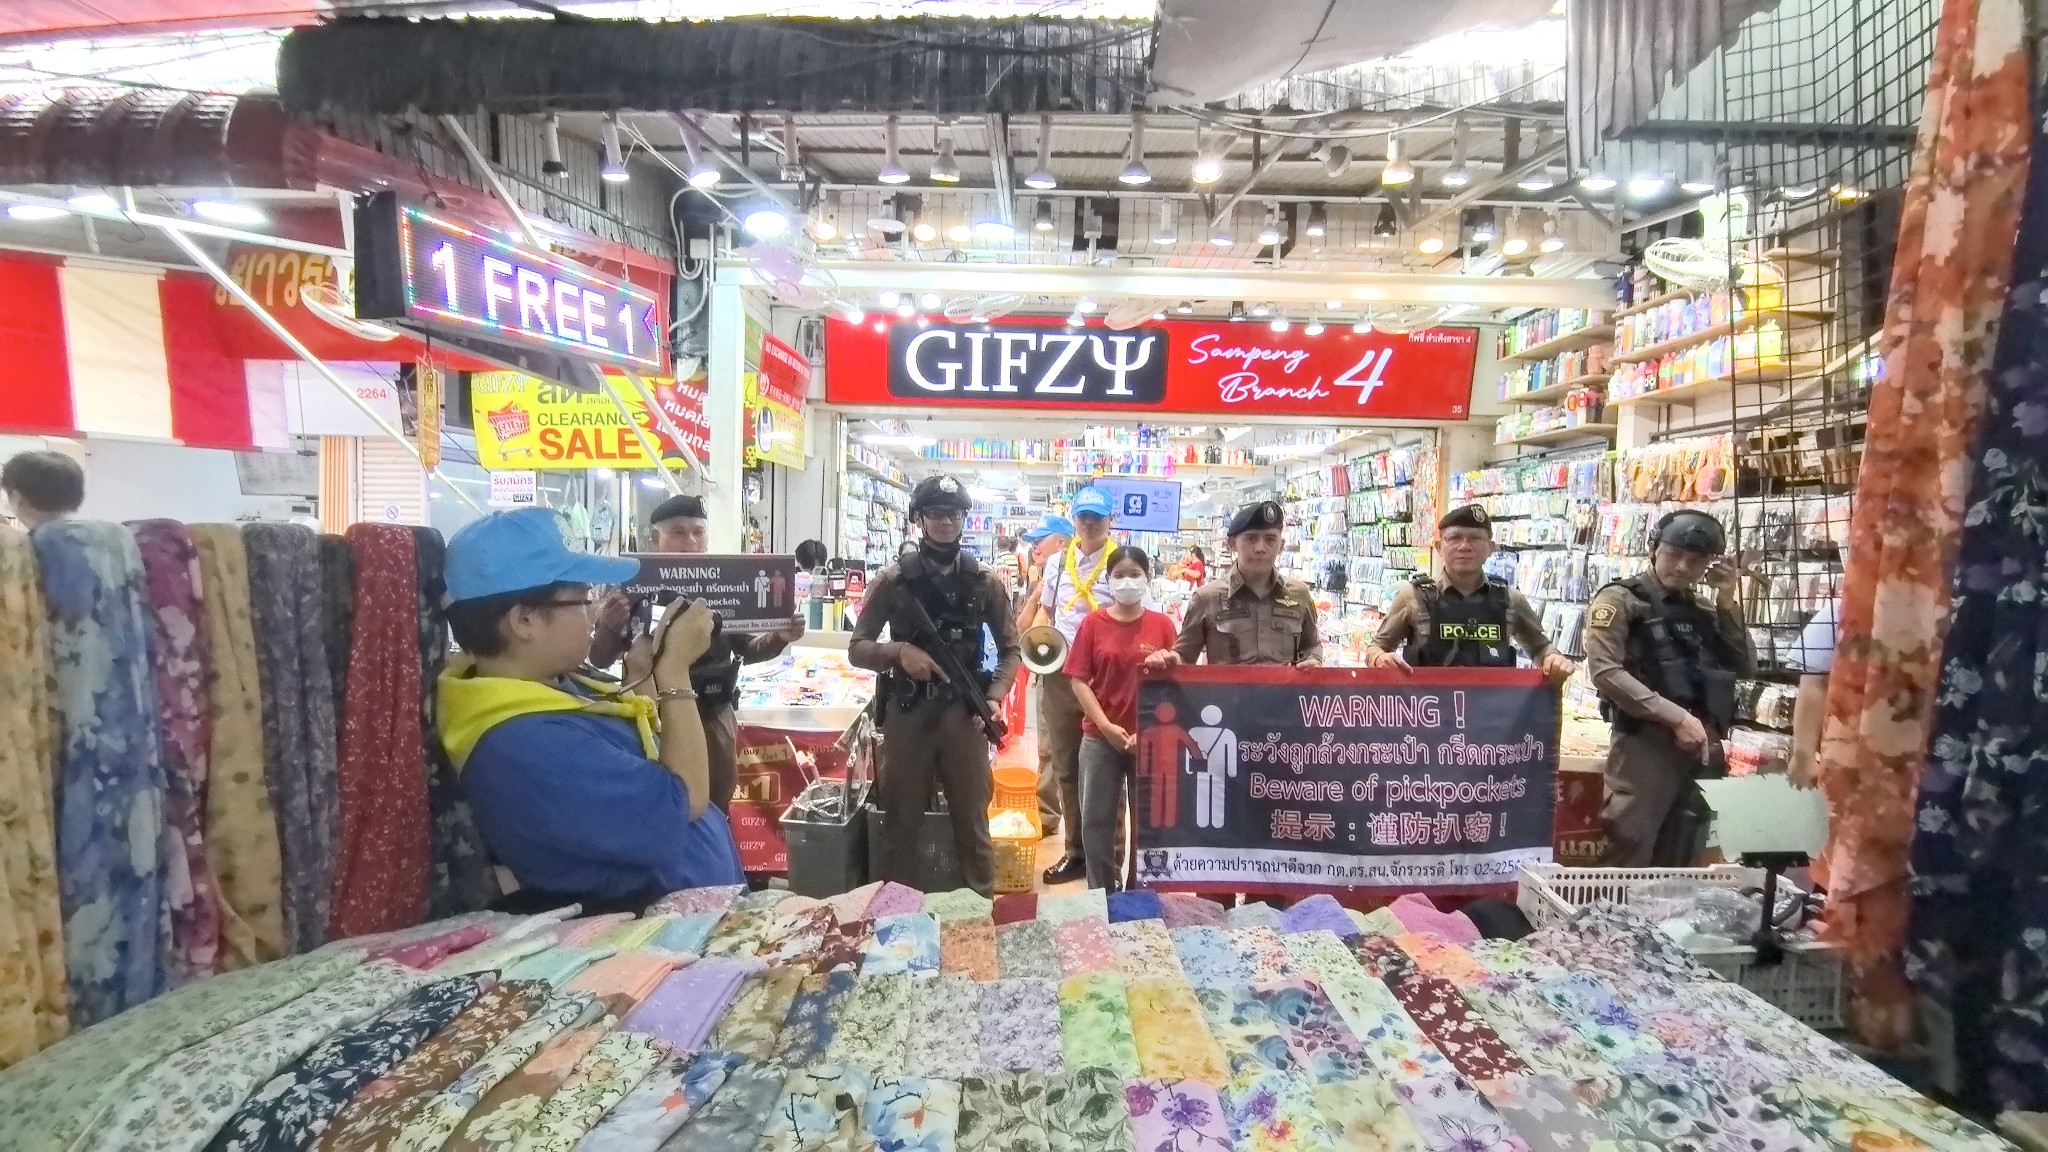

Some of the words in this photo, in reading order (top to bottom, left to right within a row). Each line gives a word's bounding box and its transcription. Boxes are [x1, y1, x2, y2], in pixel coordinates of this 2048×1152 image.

[432, 241, 458, 314] 1
[483, 255, 608, 348] FREE
[618, 303, 634, 354] 1
[1188, 334, 1310, 374] Sampeng
[1217, 371, 1330, 403] Branch
[1333, 347, 1393, 405] 4
[356, 387, 387, 399] 2264
[1451, 405, 1462, 414] 35
[539, 428, 642, 460] SALE
[659, 567, 721, 579] WARNING!
[1299, 695, 1441, 728] WARNING
[1238, 732, 1430, 775] ระวังถูกล้วงกระเป๋า
[1250, 773, 1344, 801] Beware
[1352, 773, 1379, 801] of
[1386, 774, 1527, 809] pickpockets
[1449, 859, 1470, 876] โทร
